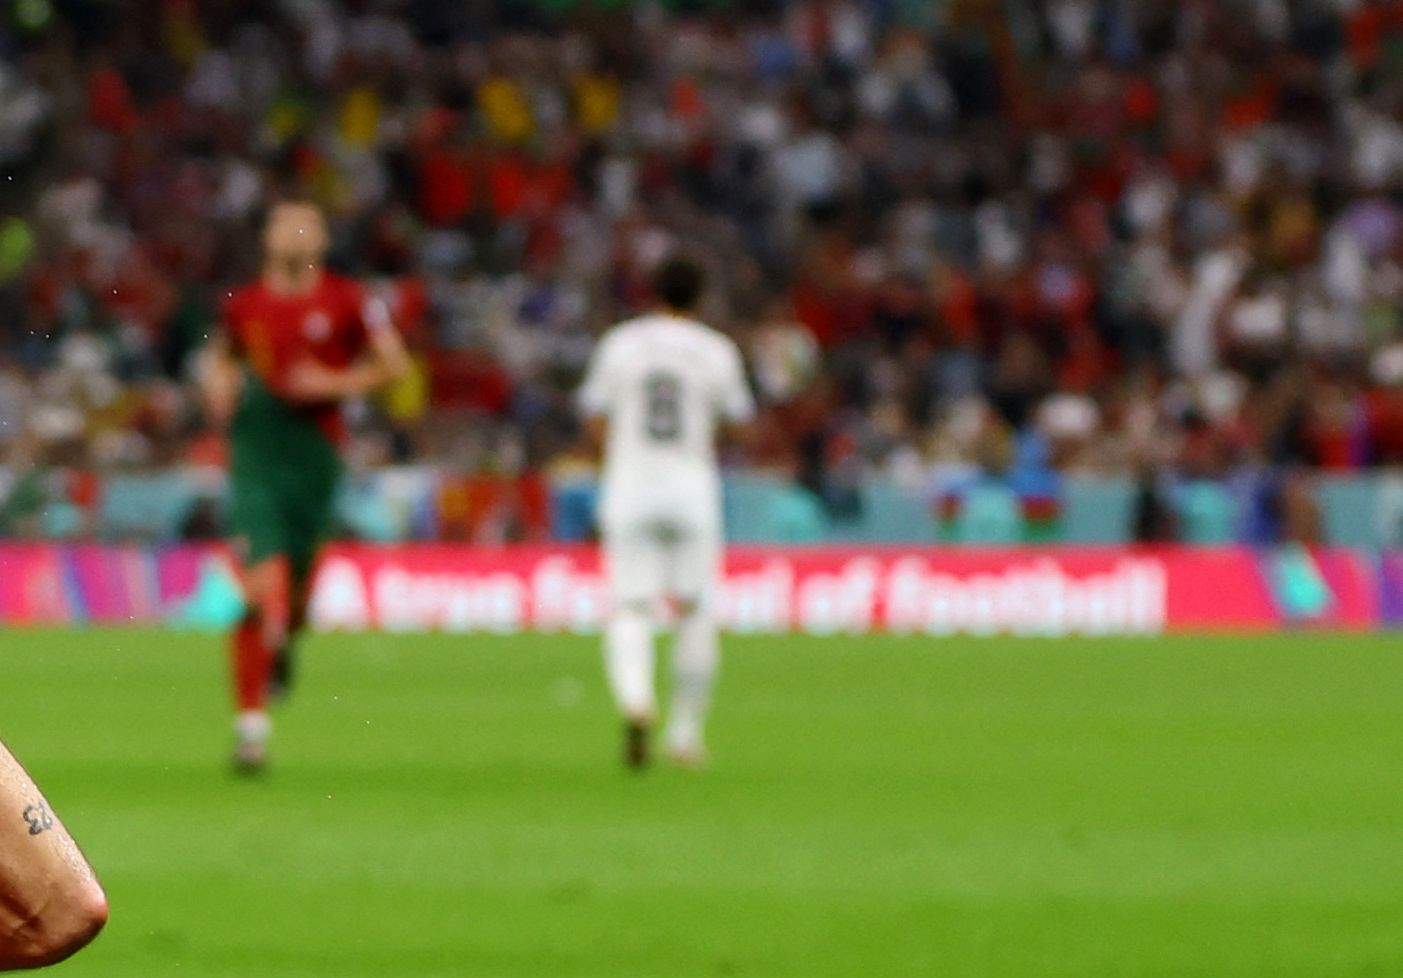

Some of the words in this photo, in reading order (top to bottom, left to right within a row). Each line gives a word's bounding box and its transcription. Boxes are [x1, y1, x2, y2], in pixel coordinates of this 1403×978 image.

[308, 554, 369, 632] A
[798, 554, 874, 633] of
[885, 553, 1168, 635] football
